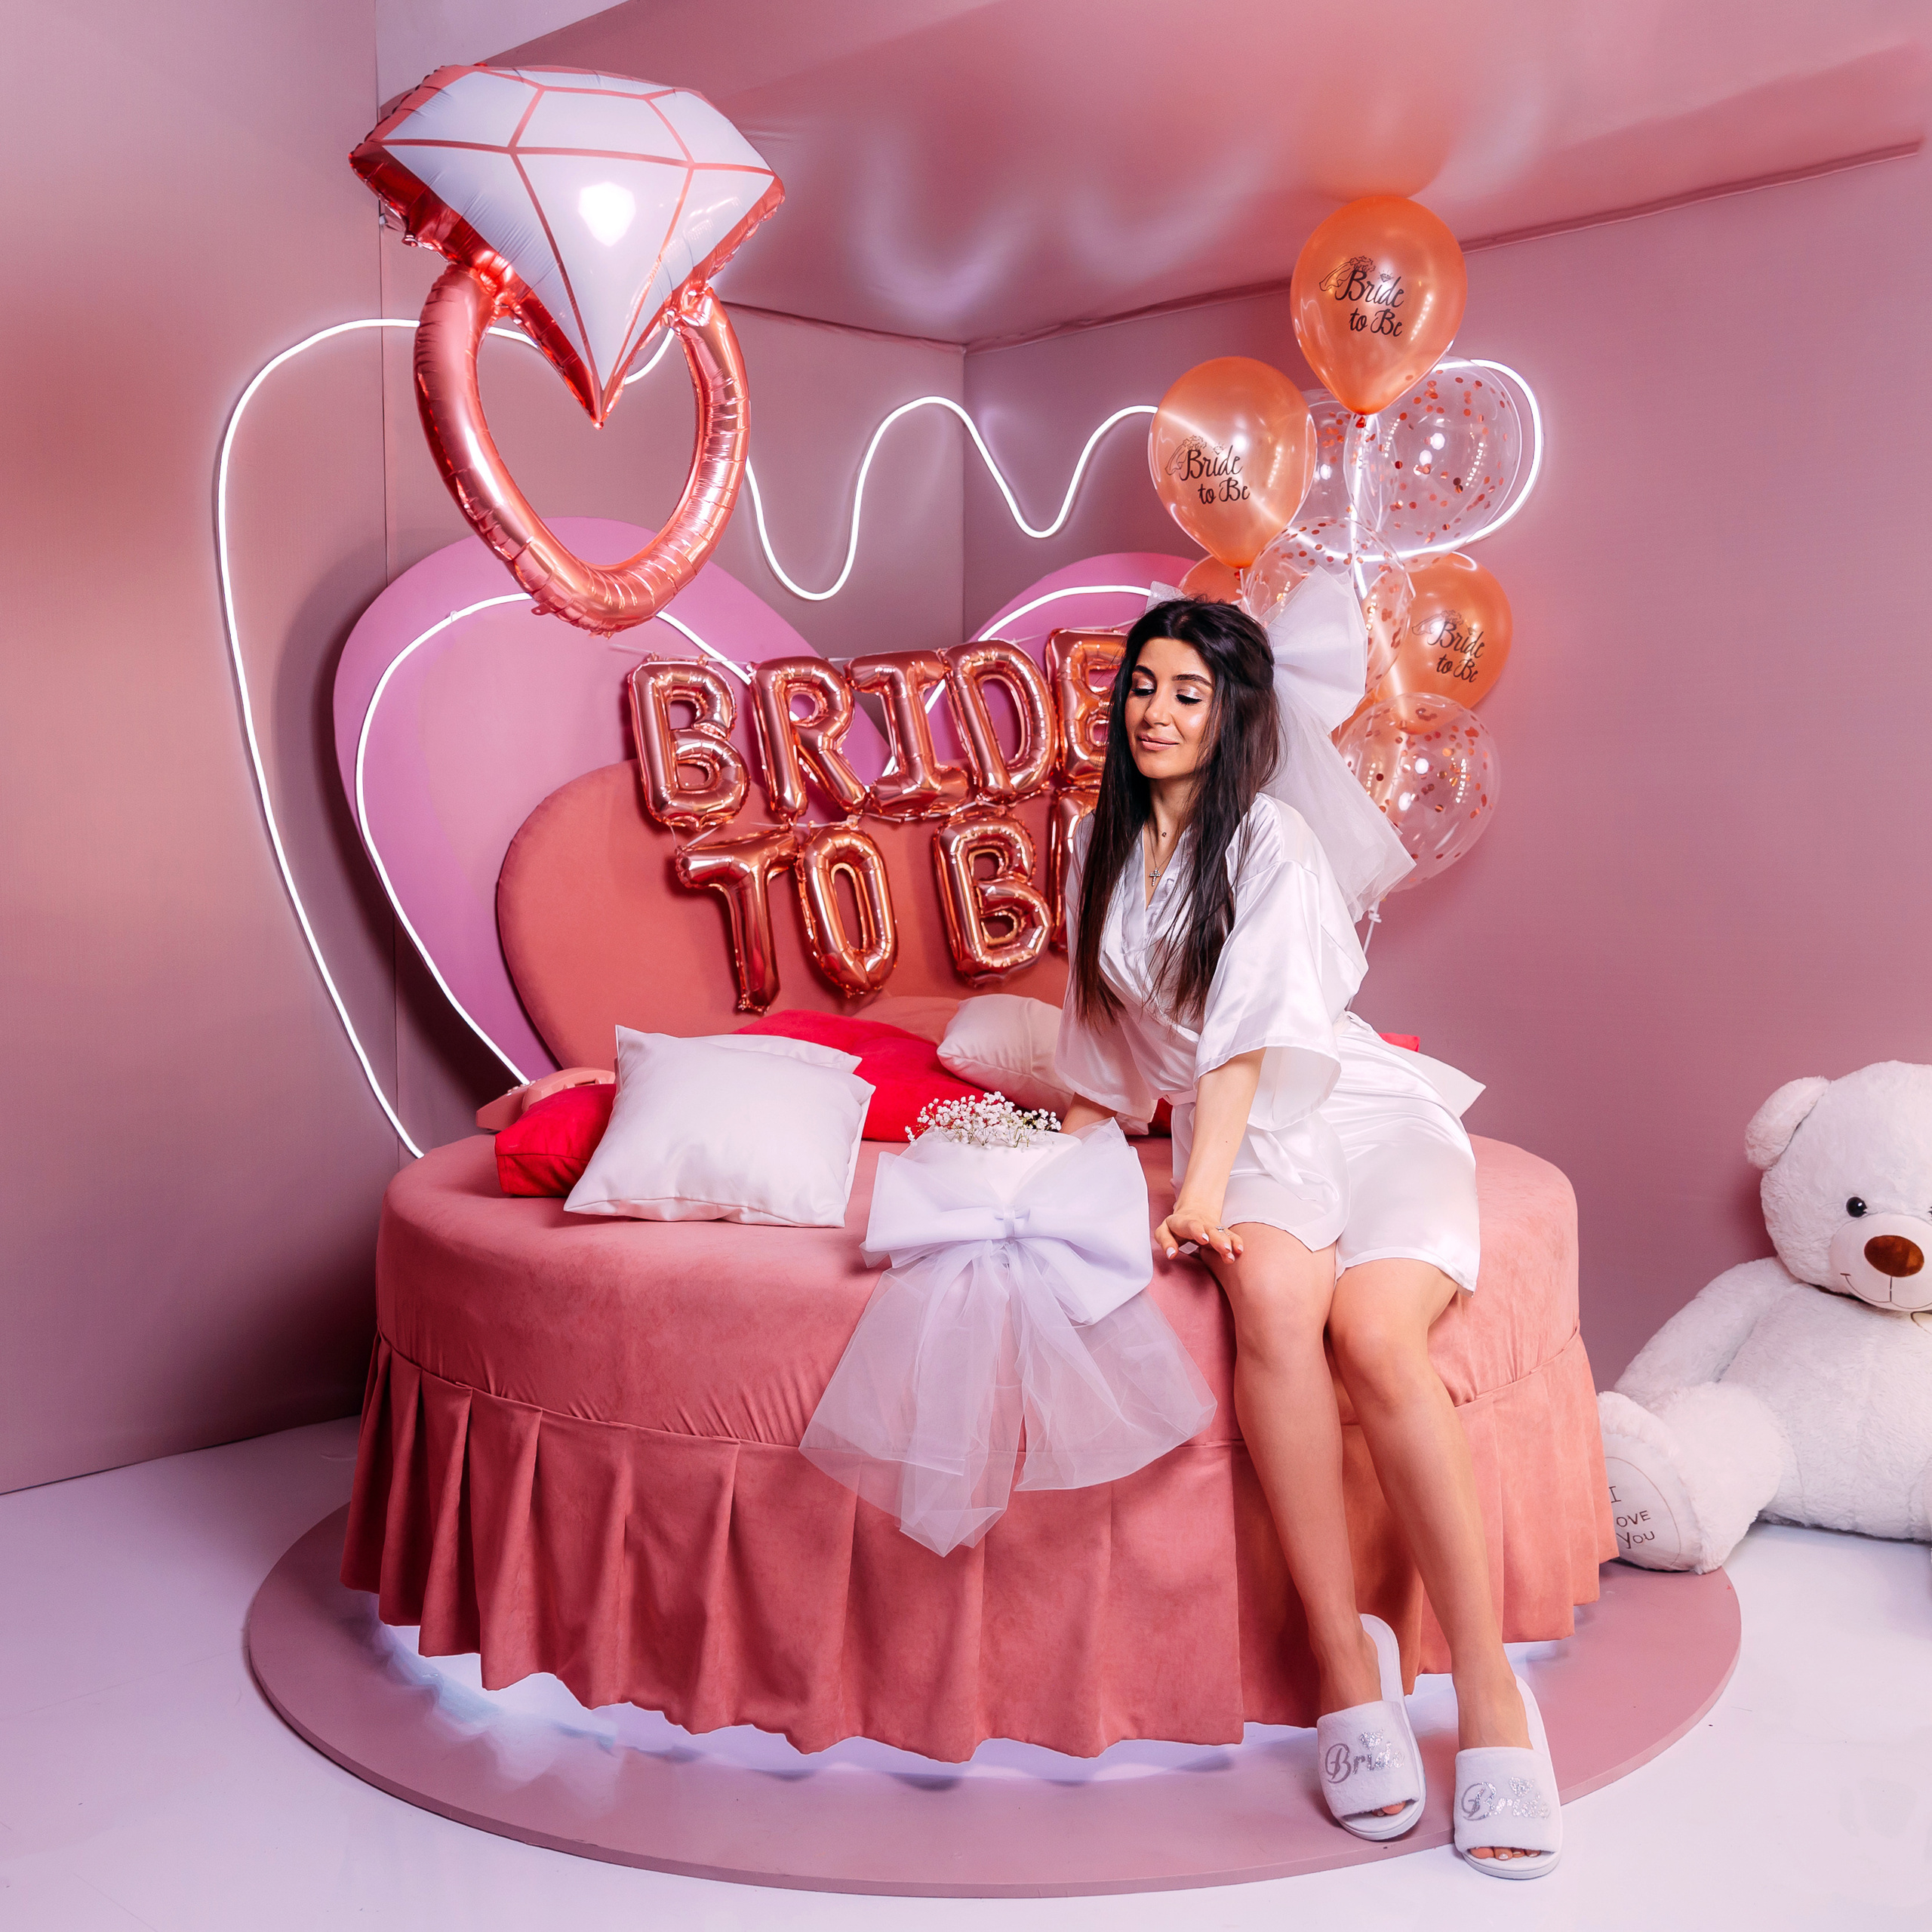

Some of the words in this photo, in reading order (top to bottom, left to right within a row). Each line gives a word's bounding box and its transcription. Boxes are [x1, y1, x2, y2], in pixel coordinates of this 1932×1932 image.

[1334, 269, 1404, 308] Bride
[1349, 307, 1368, 332] to
[1370, 308, 1403, 337] Be
[1179, 444, 1244, 481] Bride
[1197, 483, 1217, 505] to
[1218, 476, 1251, 503] Be
[1426, 620, 1485, 659] Bride
[1435, 654, 1453, 674] to
[1453, 658, 1478, 683] Be
[675, 821, 900, 1015] TO
[1608, 1485, 1622, 1503] I
[1616, 1509, 1651, 1528] OVE
[1324, 1740, 1406, 1785] Bride
[1460, 1781, 1552, 1822] Bride
